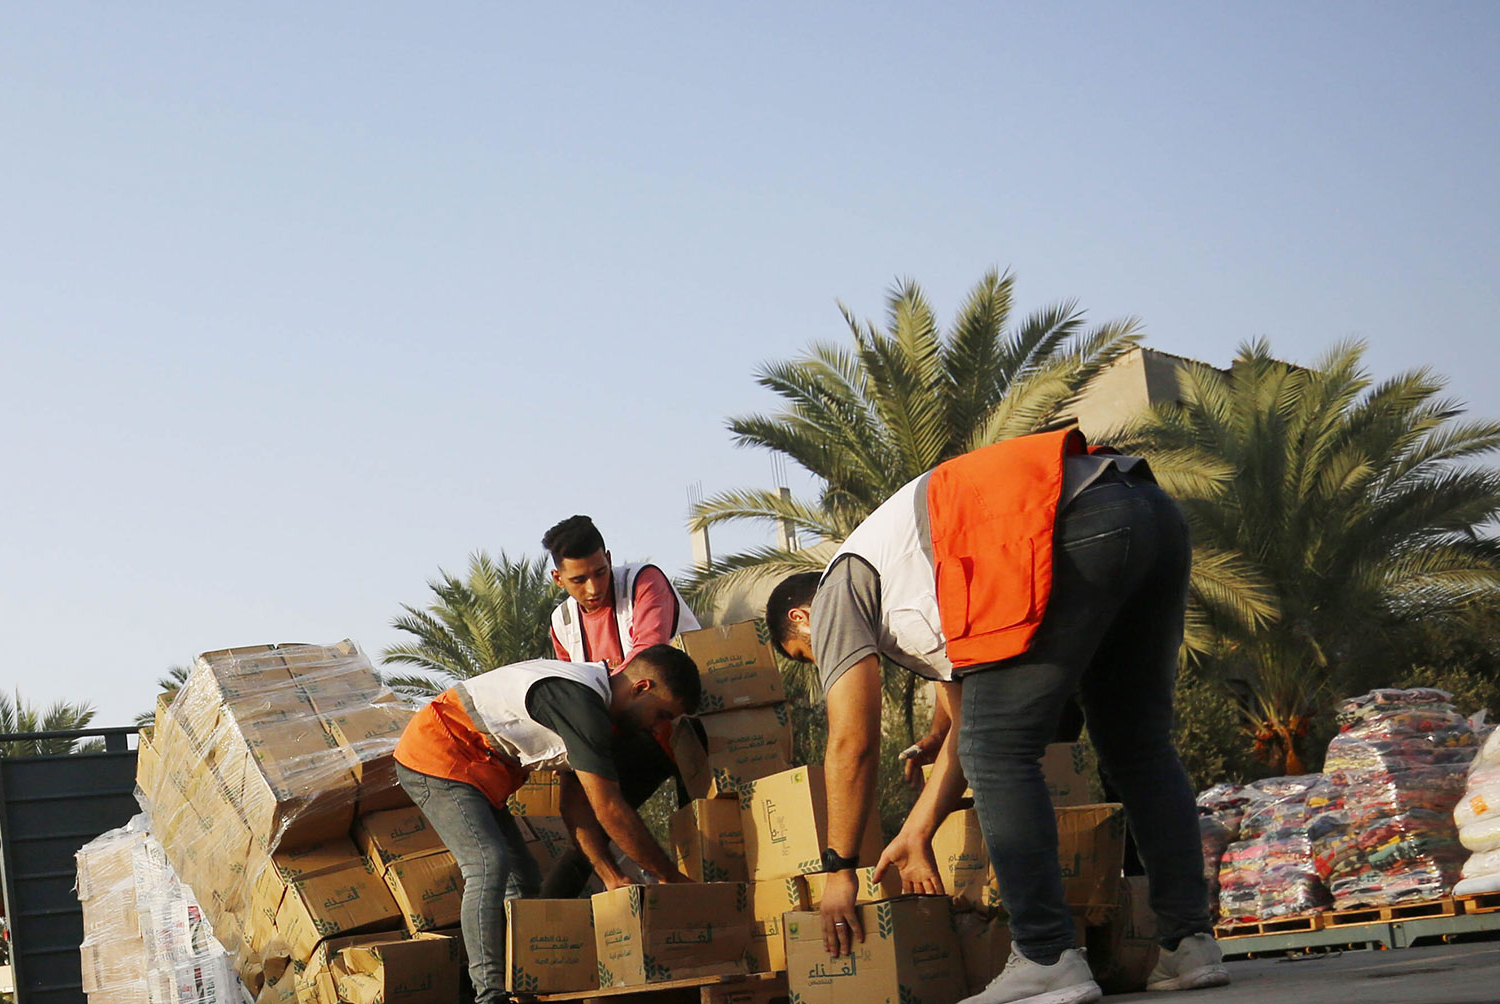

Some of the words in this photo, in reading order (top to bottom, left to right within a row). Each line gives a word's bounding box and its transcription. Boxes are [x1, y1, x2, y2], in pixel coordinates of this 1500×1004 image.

[766, 799, 787, 845] الغذاء
[665, 923, 712, 945] الغذاء
[808, 951, 857, 979] الغذاء
